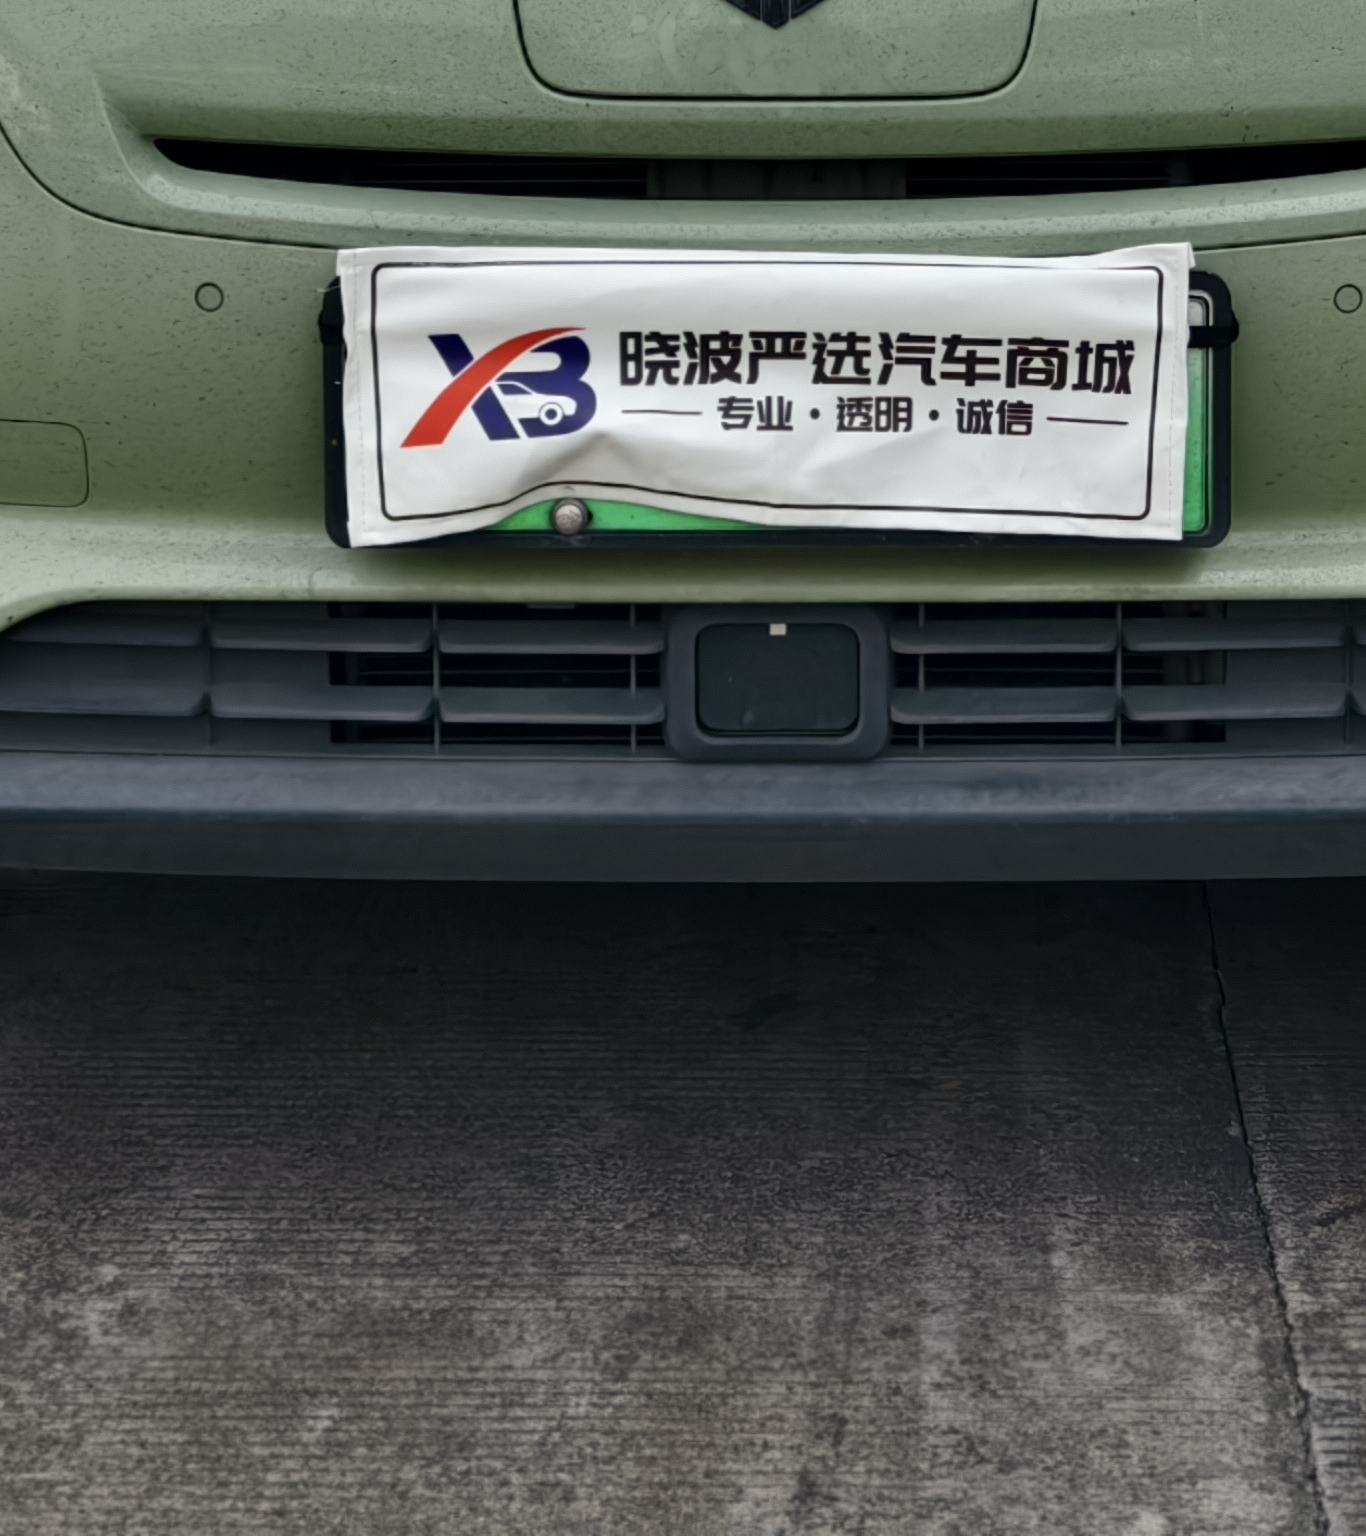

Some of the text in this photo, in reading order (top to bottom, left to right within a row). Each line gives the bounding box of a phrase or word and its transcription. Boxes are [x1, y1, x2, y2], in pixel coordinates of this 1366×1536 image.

[619, 330, 1135, 394] 晓波严选汽车商城
